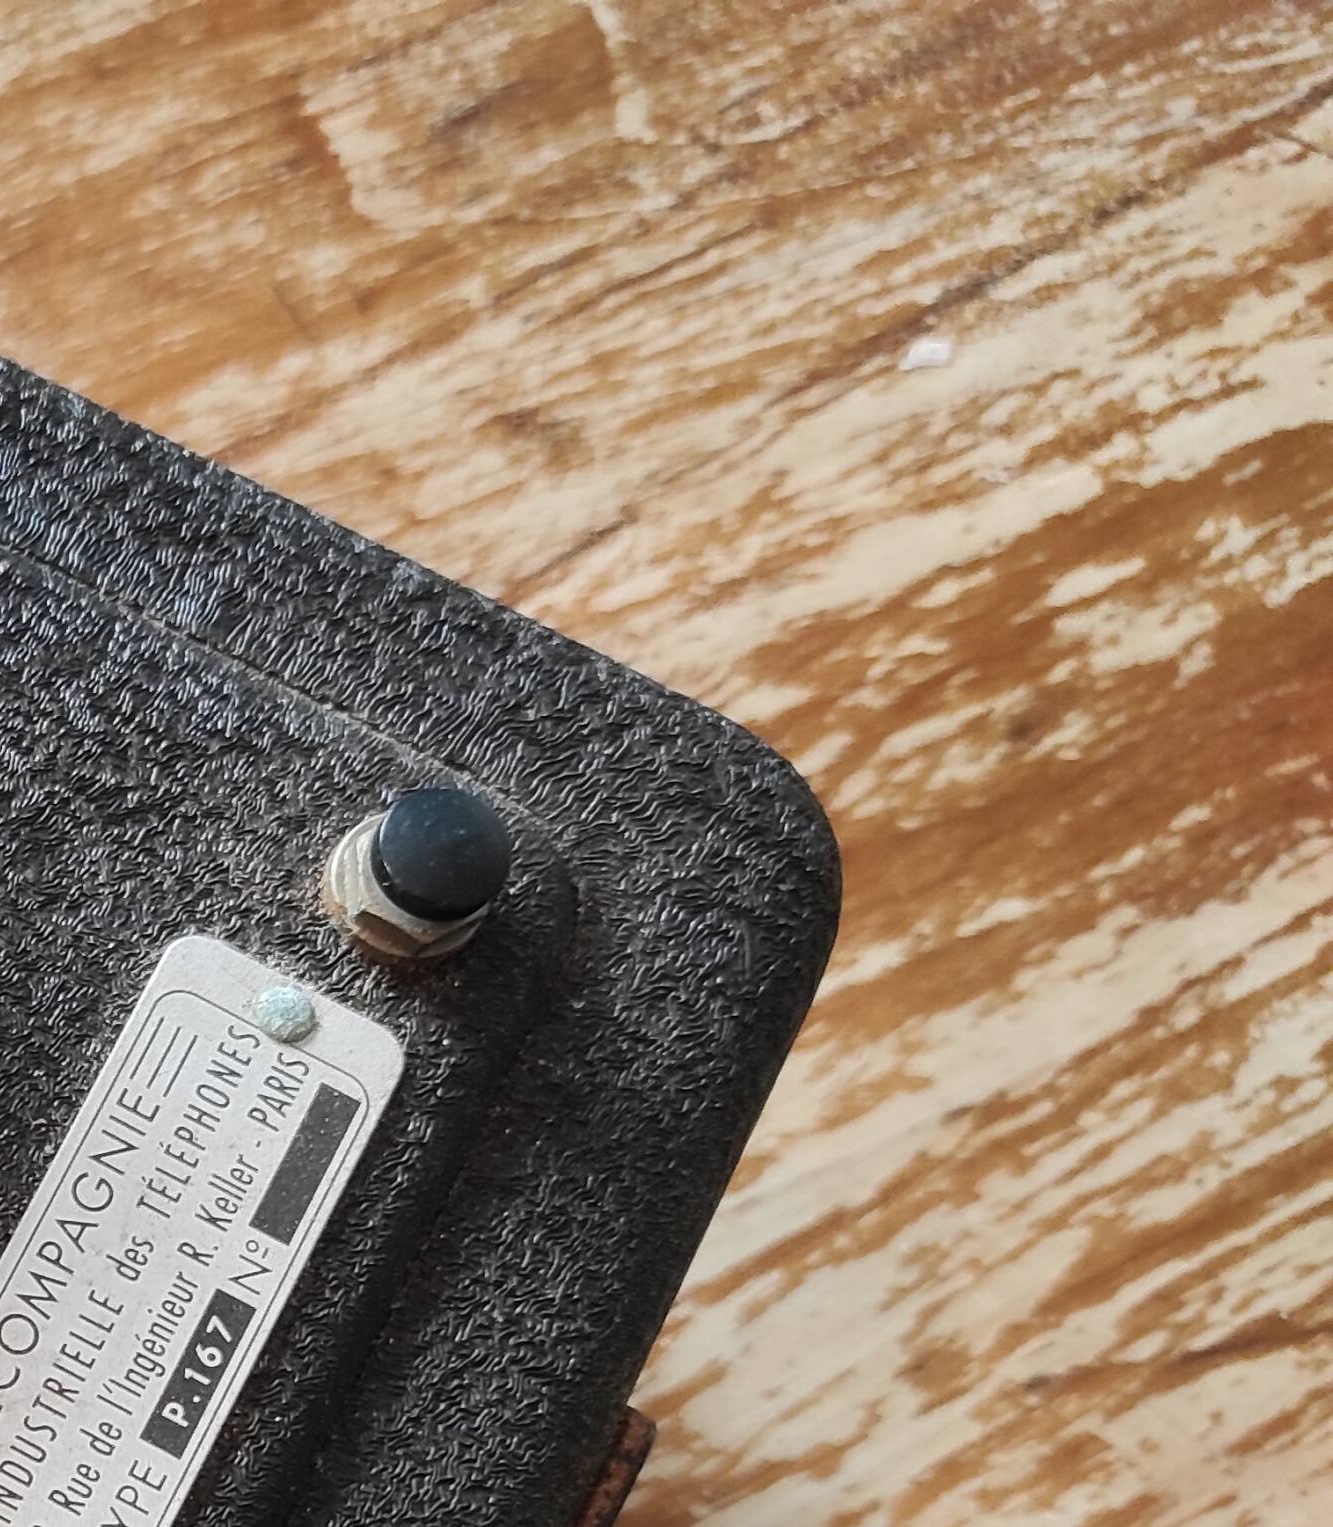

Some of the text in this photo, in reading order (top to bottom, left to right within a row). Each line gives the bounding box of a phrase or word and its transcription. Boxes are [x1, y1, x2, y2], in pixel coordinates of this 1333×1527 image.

[247, 1052, 310, 1132] PARIS
[106, 1235, 154, 1282] des
[136, 1025, 261, 1219] TÉLÉPHONES
[194, 1153, 260, 1232] Keller
[177, 1241, 219, 1267] R.
[161, 1314, 233, 1428] P.167
[80, 1421, 123, 1456] de
[48, 1463, 101, 1516] Rue
